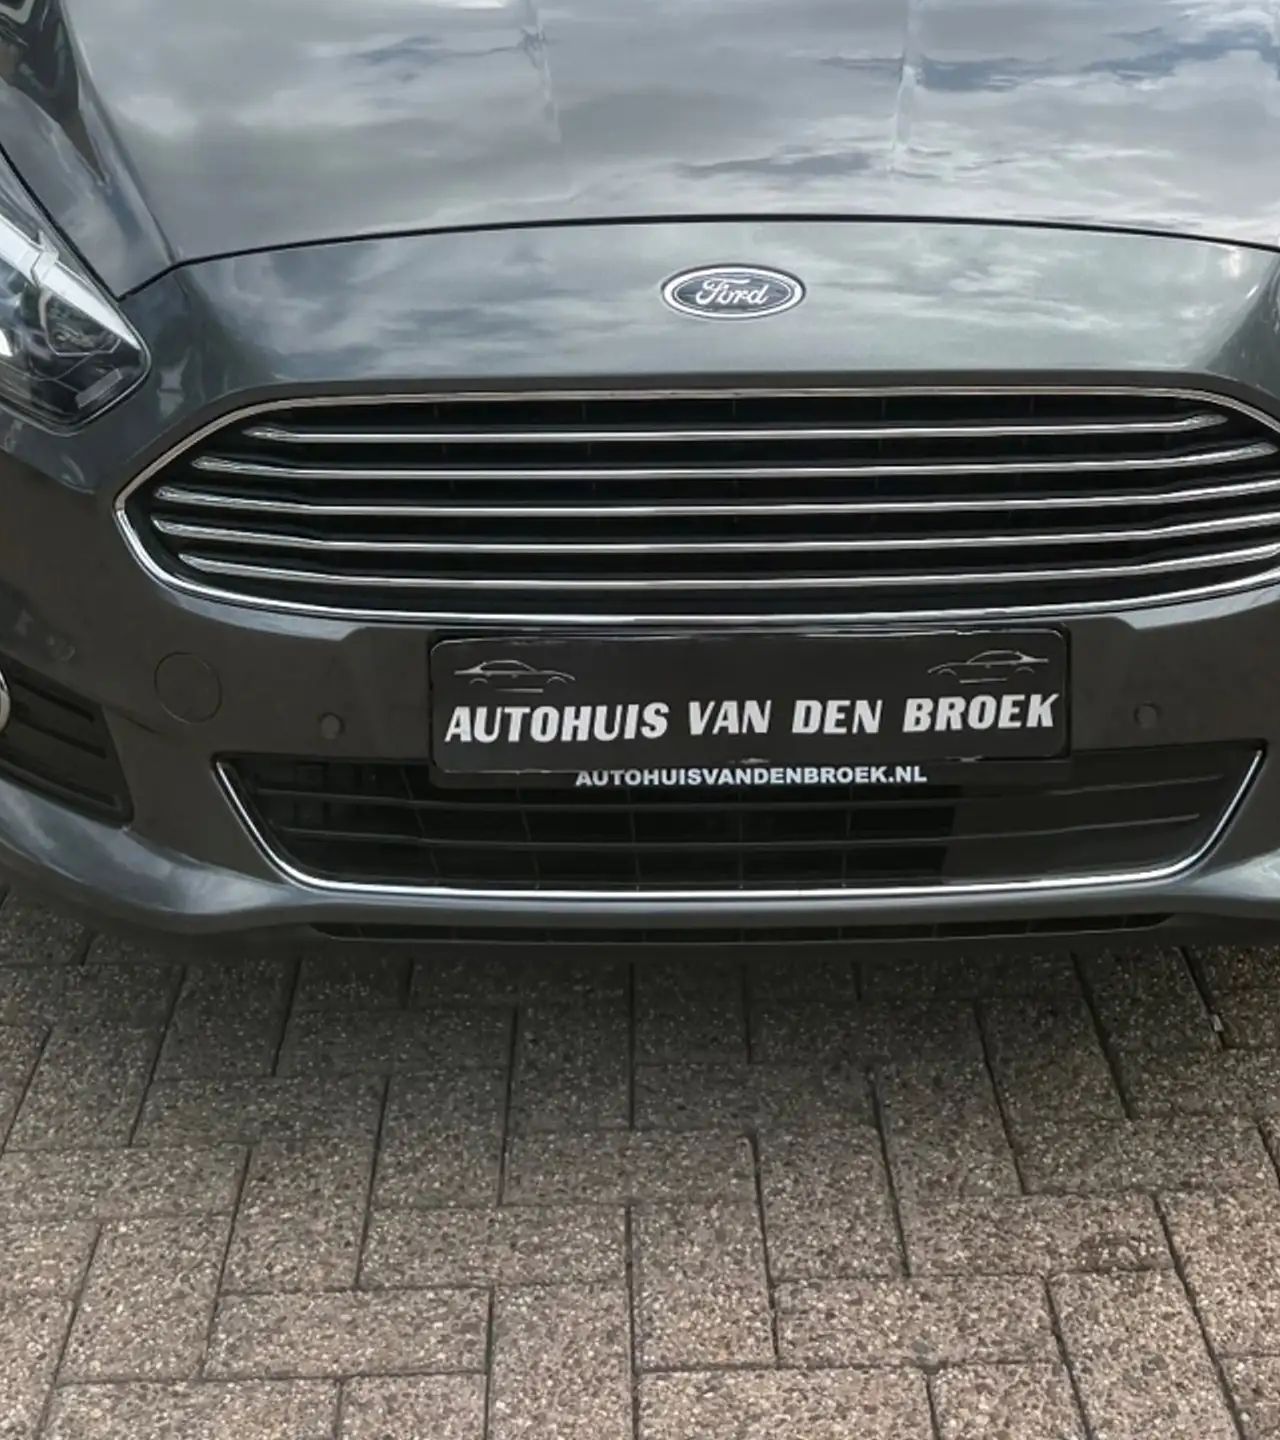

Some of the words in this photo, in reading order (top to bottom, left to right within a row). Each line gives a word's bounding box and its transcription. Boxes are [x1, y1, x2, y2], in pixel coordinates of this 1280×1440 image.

[695, 276, 770, 305] Ford
[444, 702, 670, 744] AUTOHUIS
[687, 699, 773, 736] VAN
[791, 699, 883, 735] DEN
[902, 693, 1059, 733] BROEK
[574, 765, 928, 787] AUTOHUISVANDENBROEK.NL
